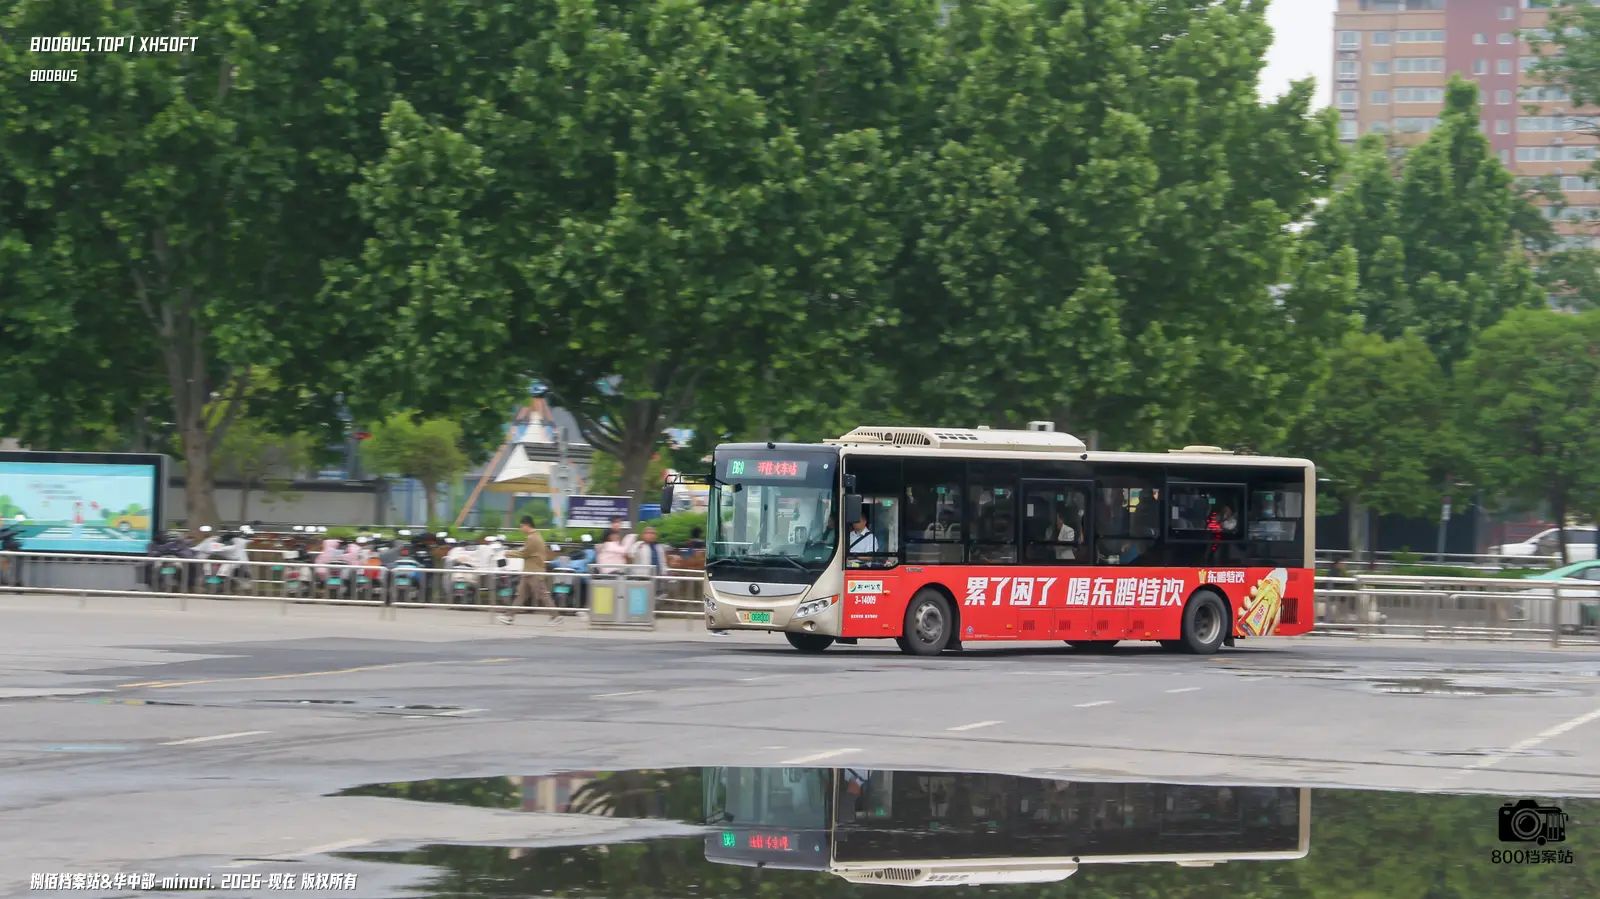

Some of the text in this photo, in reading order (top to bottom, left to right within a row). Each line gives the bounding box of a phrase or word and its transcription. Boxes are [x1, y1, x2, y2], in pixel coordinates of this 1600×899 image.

[1207, 570, 1245, 583] 东鹏特饮
[963, 576, 1185, 607] 累了困了 喝东鹏特饮
